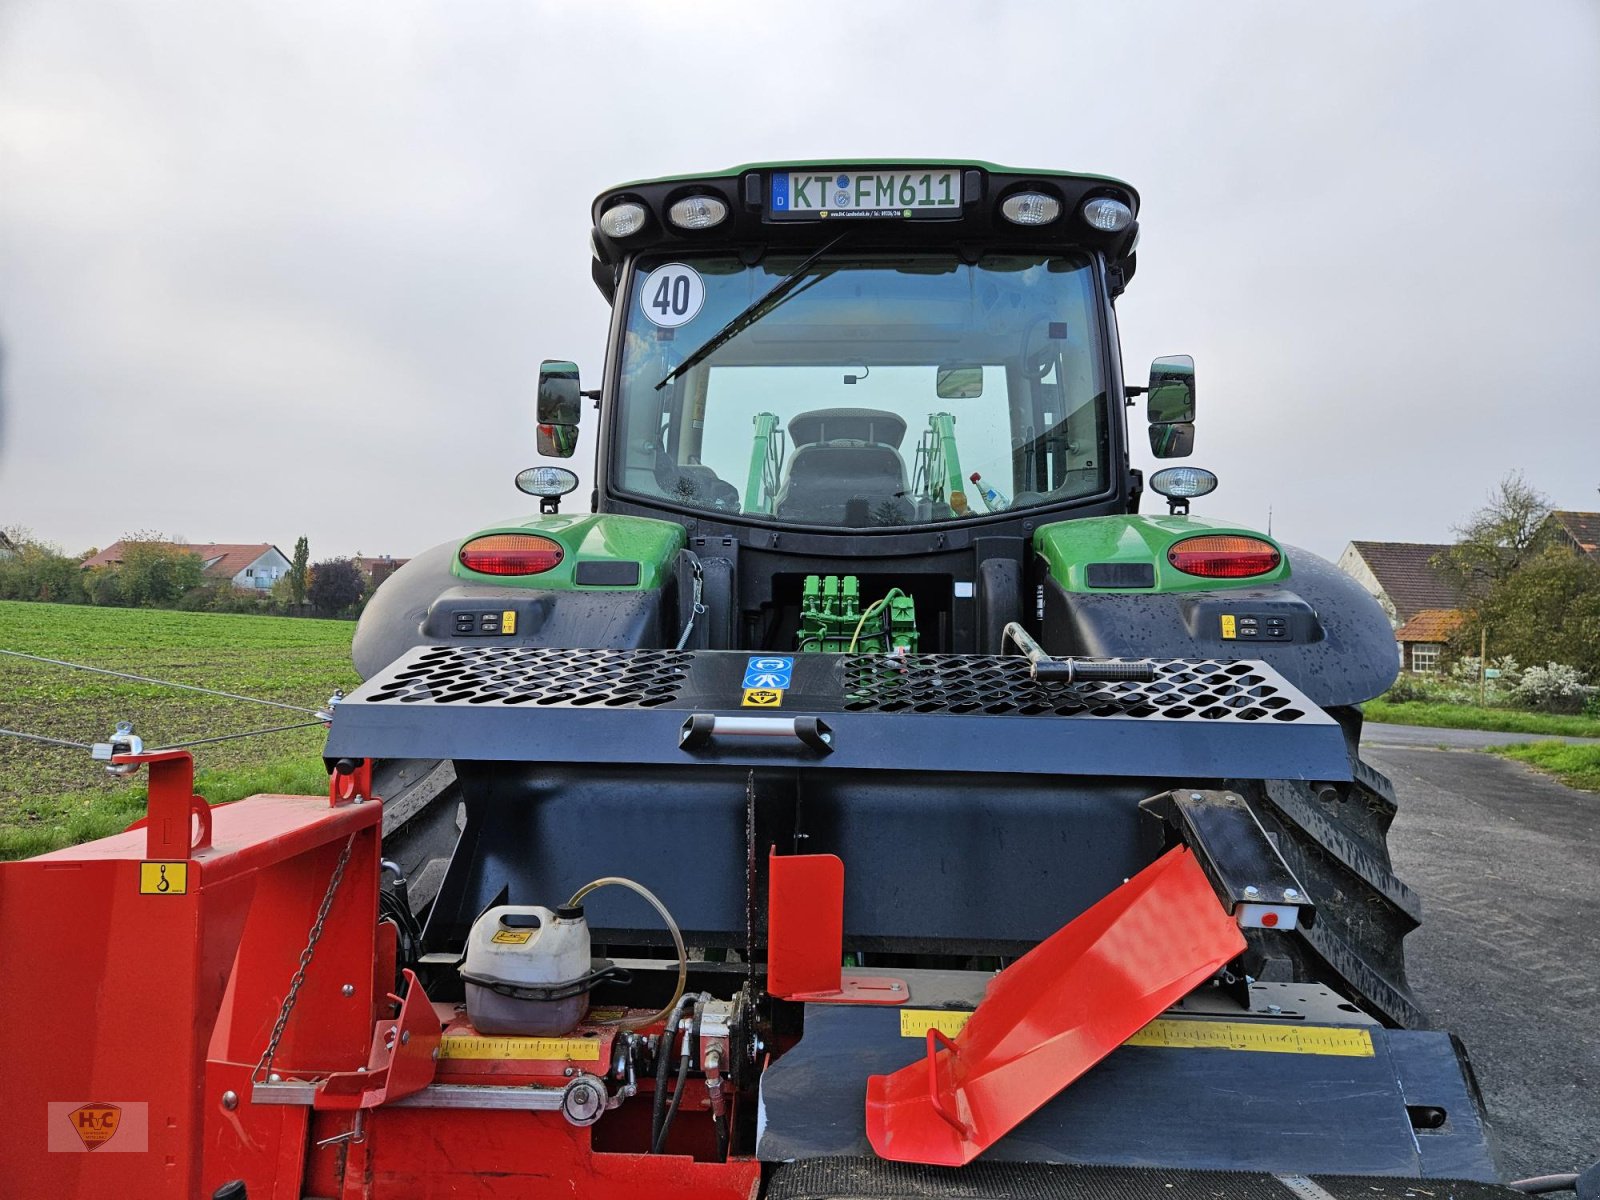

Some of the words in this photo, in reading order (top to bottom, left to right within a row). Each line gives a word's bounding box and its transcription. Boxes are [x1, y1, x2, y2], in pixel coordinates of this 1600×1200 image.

[777, 196, 785, 206] D
[793, 176, 834, 209] KT
[652, 274, 691, 316] 40
